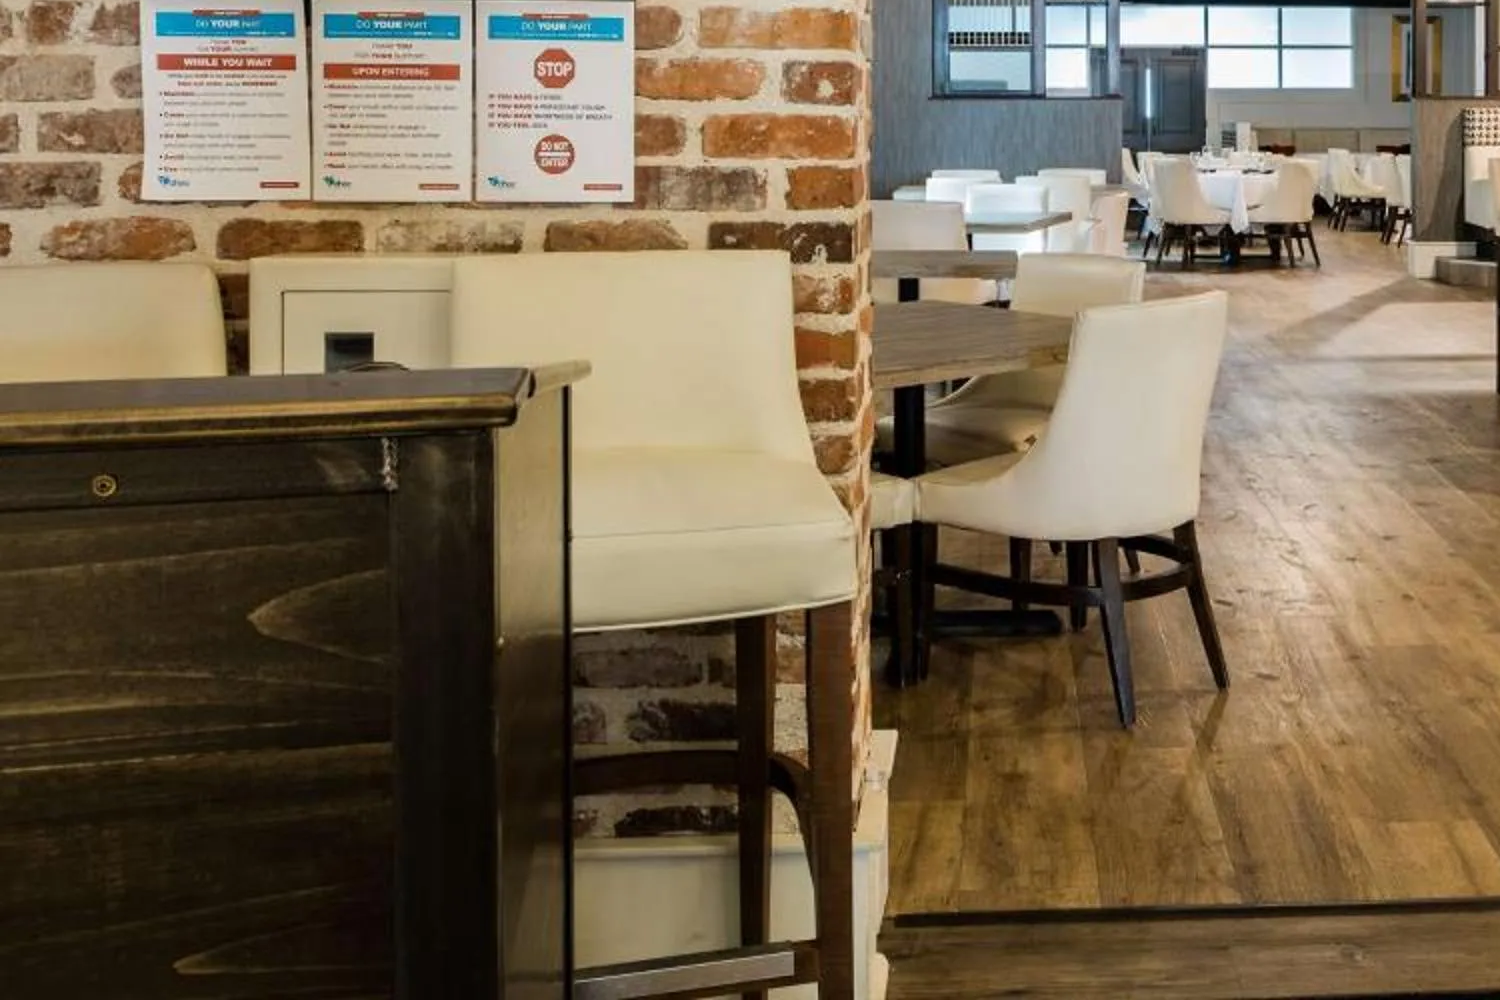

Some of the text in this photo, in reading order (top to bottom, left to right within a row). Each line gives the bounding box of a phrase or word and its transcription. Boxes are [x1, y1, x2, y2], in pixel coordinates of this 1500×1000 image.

[211, 19, 240, 29] YOUR
[373, 19, 402, 29] YOUR
[538, 21, 568, 31] YOUR
[183, 57, 273, 67] WHILE YOU WAIT
[537, 61, 573, 77] STOP
[541, 142, 569, 151] DO NOT
[541, 158, 568, 167] ENTER
